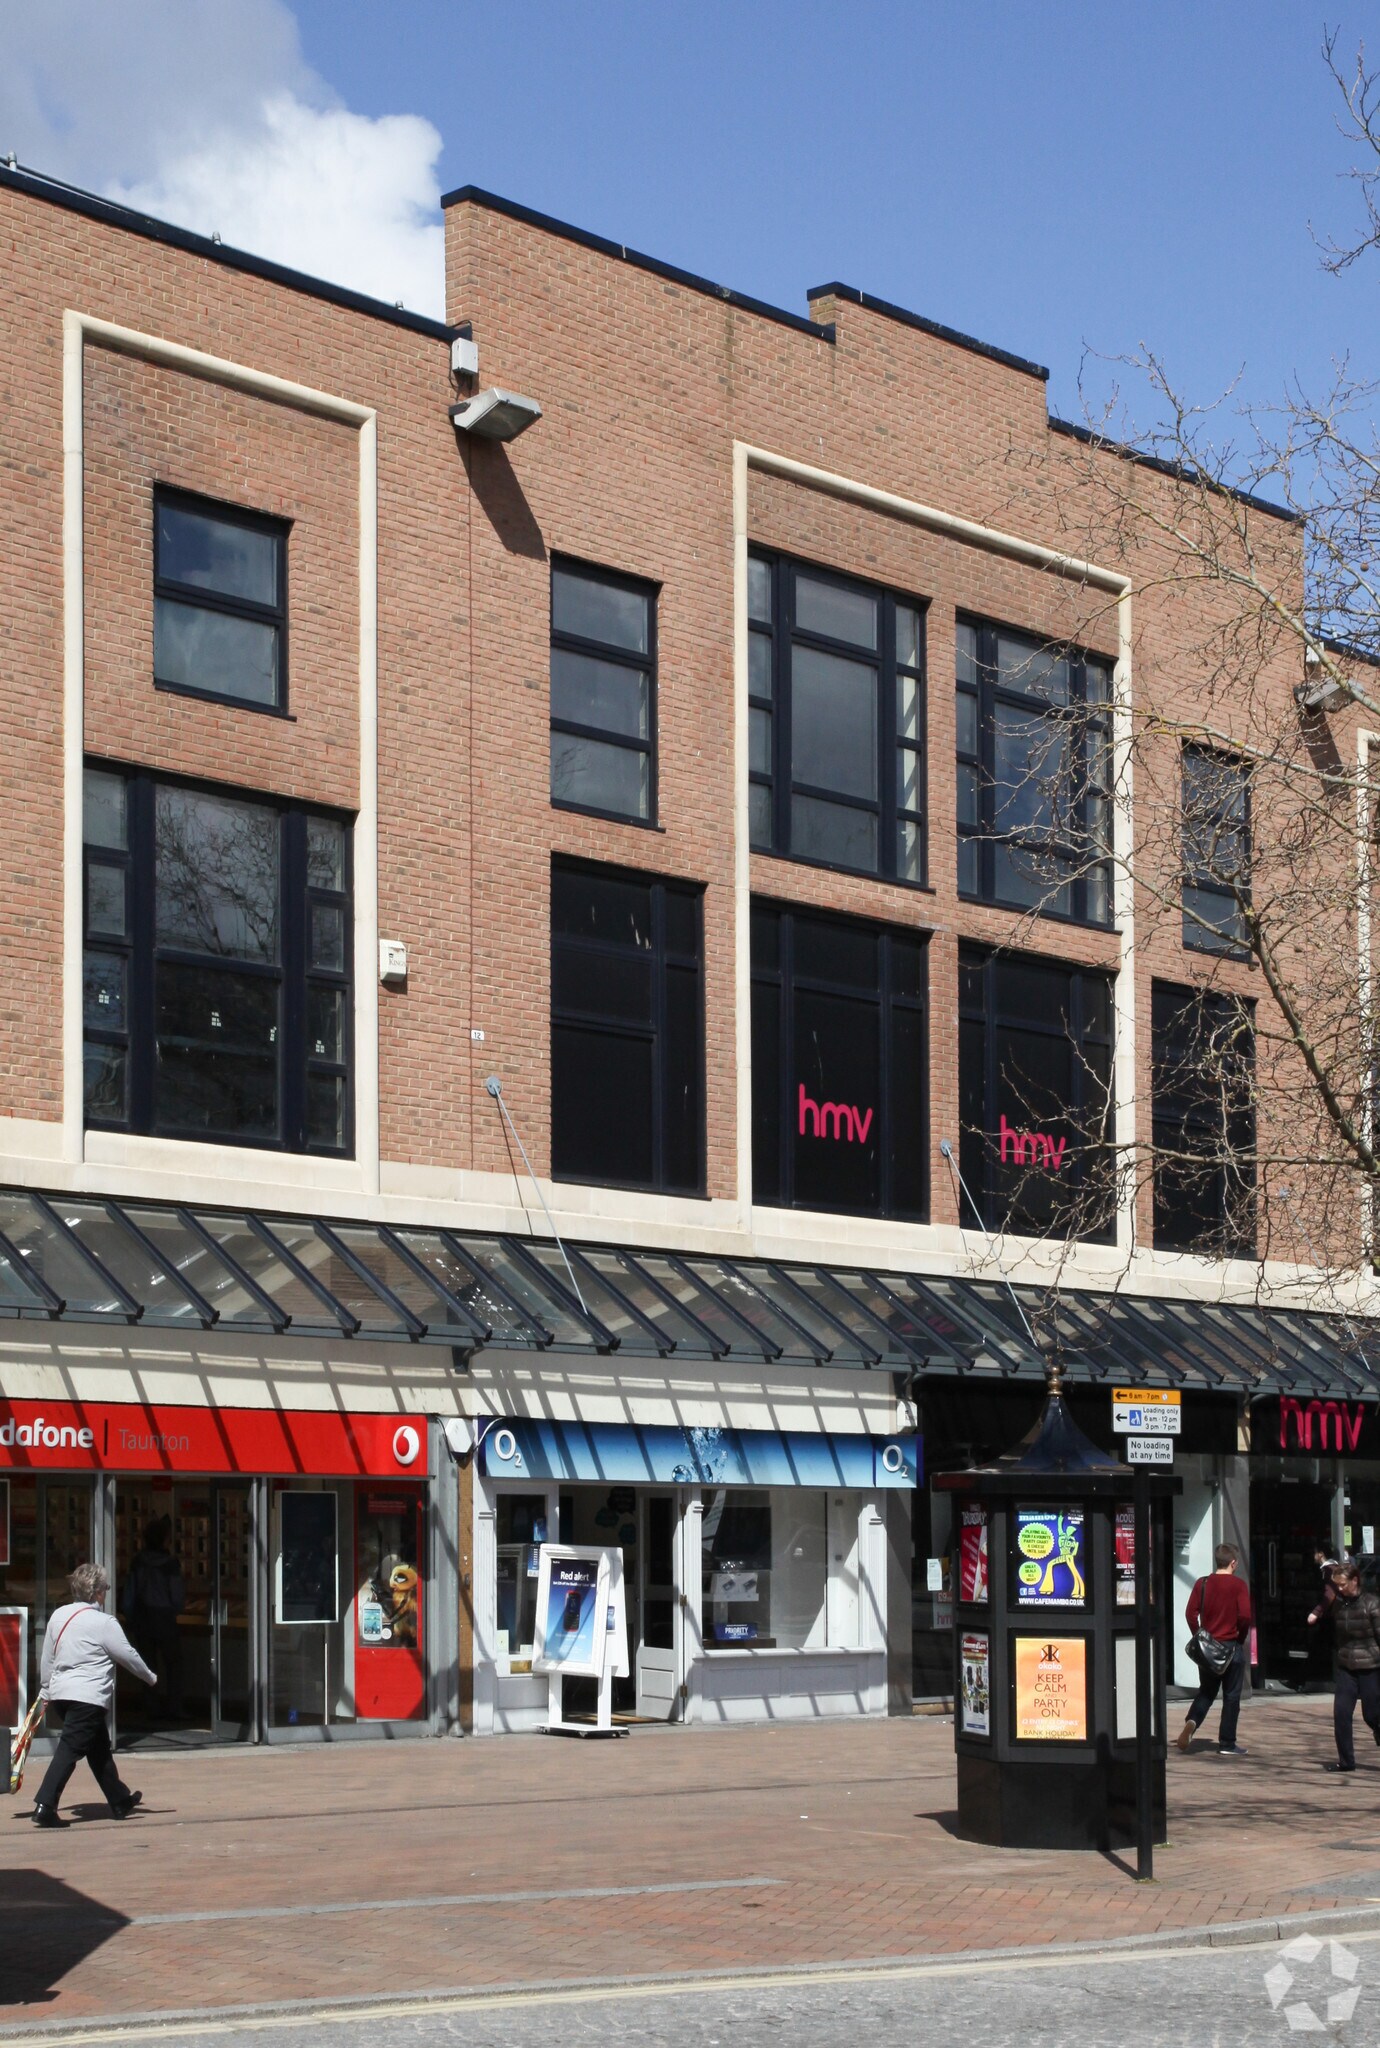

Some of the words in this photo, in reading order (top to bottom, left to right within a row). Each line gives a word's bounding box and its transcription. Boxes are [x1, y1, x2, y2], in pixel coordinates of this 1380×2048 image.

[474, 1031, 481, 1040] 12
[799, 1083, 873, 1144] hmv
[1000, 1114, 1066, 1171] hmv
[1143, 1406, 1165, 1414] Loading
[1166, 1407, 1179, 1415] only
[1280, 1395, 1365, 1452] hmv
[118, 1428, 190, 1451] Taunton
[1130, 1440, 1142, 1449] No
[1143, 1441, 1170, 1451] loading
[1130, 1451, 1138, 1459] at
[1139, 1452, 1153, 1460] any
[1154, 1451, 1171, 1459] time
[1018, 1514, 1057, 1522] mambo
[560, 1571, 574, 1581] Red
[574, 1572, 590, 1582] alert
[1018, 1597, 1085, 1606] WWW.CAFEMAMBO.CO.UK
[724, 1626, 749, 1634] PRIORITY
[1037, 1673, 1064, 1683] KEEP
[1034, 1683, 1067, 1693] CALM
[1033, 1698, 1068, 1708] PARTY
[1041, 1708, 1060, 1718] ON
